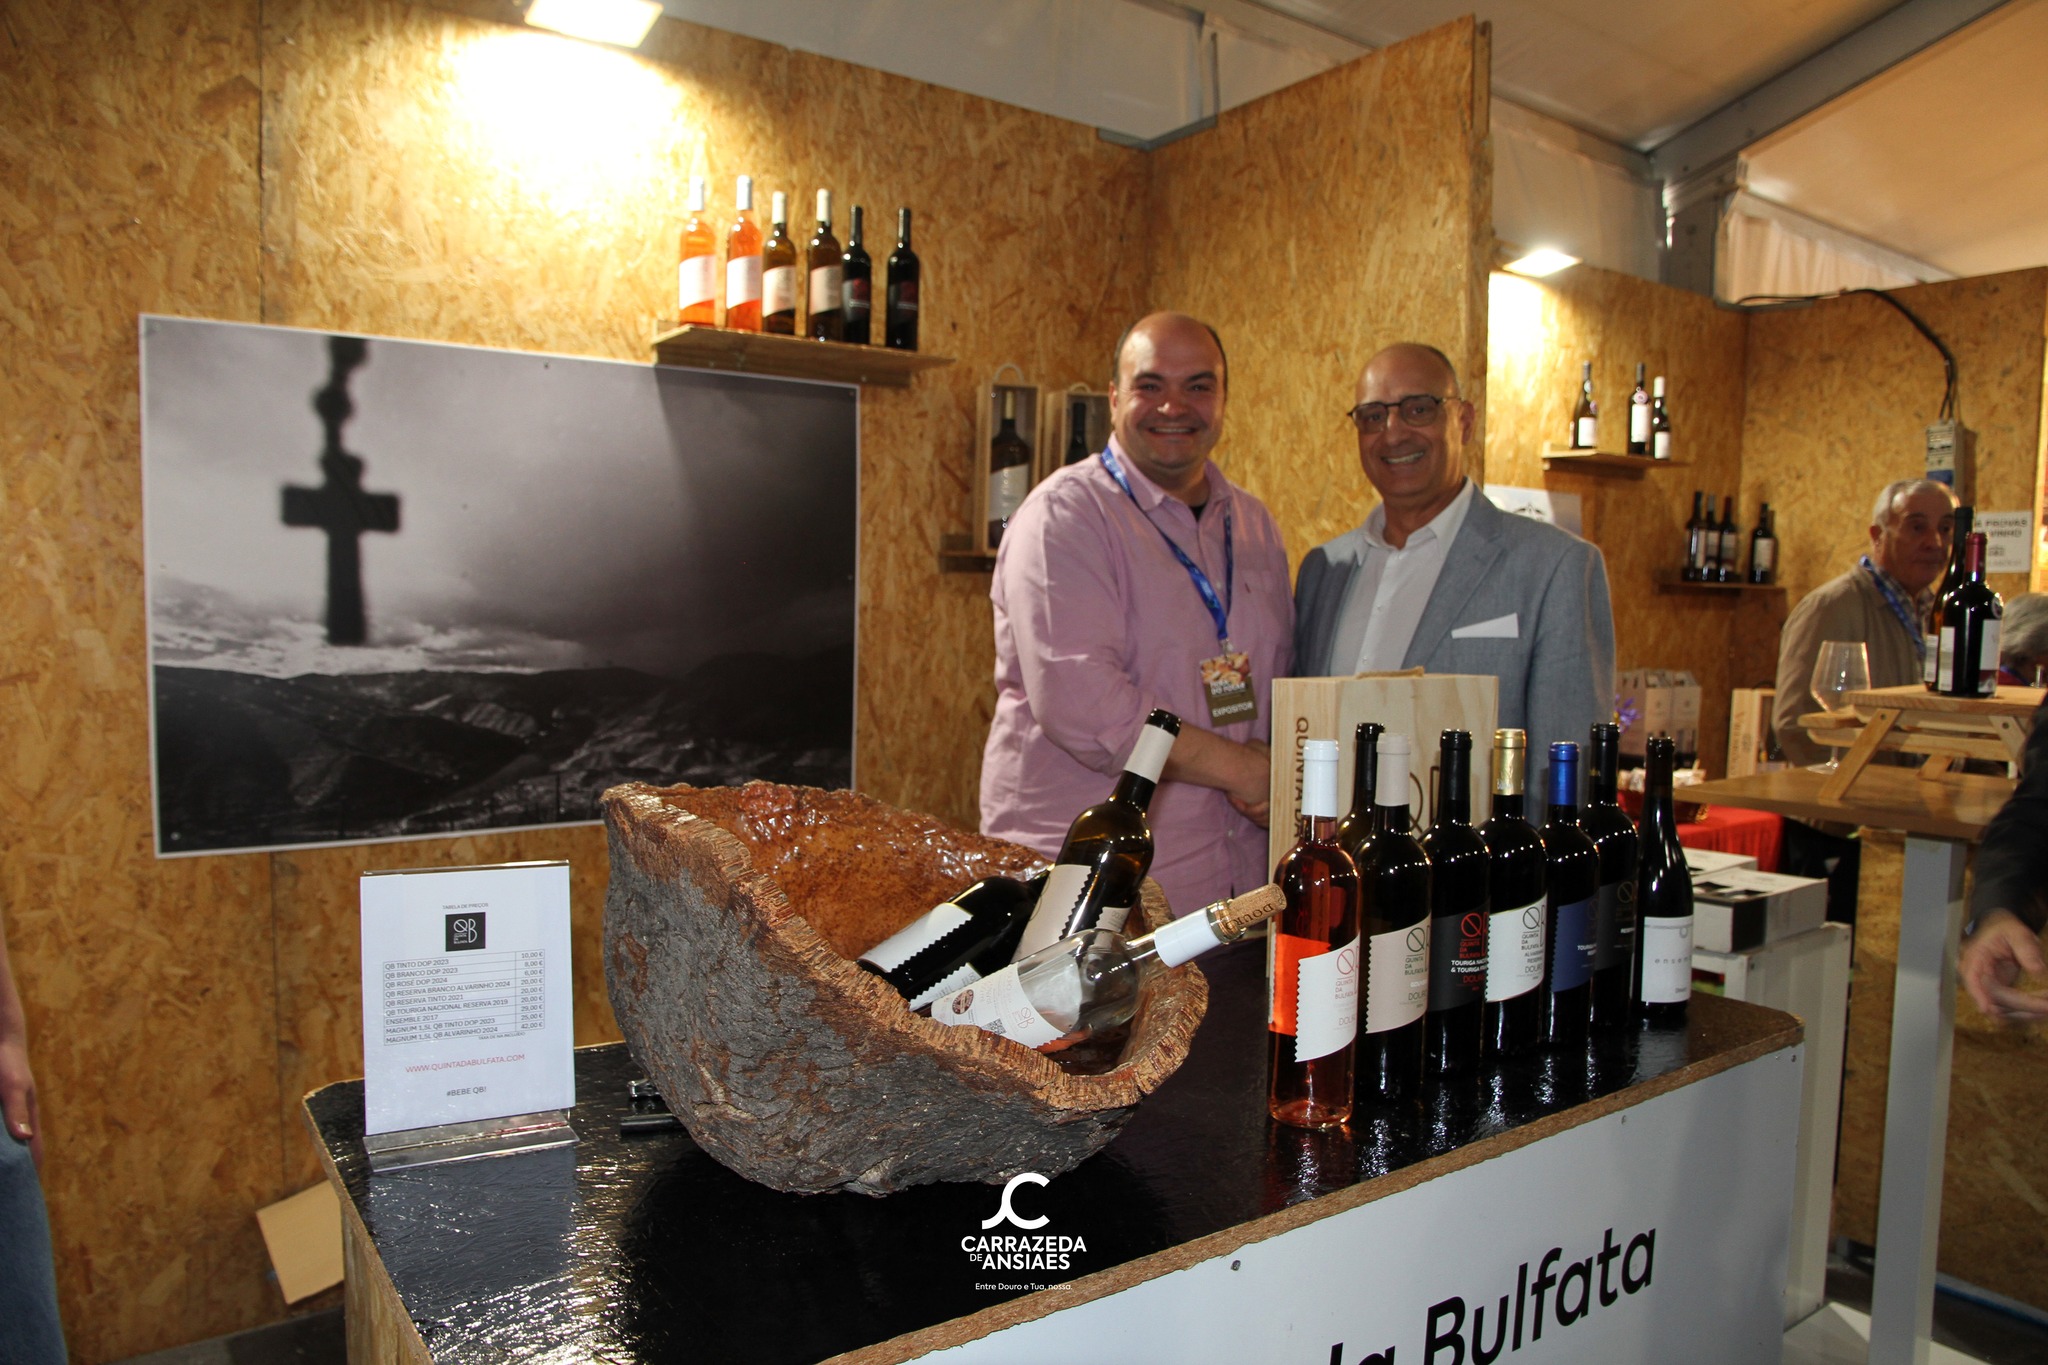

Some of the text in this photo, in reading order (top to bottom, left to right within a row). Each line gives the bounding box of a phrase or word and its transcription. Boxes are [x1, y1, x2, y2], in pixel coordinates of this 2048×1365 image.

[1212, 701, 1254, 717] EXPOSITOR
[384, 962, 396, 970] QB
[396, 961, 416, 969] TINTO
[433, 958, 449, 966] 2023
[521, 951, 538, 960] 10,00
[385, 971, 396, 979] QB
[396, 969, 426, 979] BRANCO
[426, 968, 442, 976] DOP
[442, 967, 458, 975] 2023
[1457, 965, 1480, 973] TOURIGA
[385, 980, 396, 988] QB
[396, 978, 415, 987] ROSÉ
[416, 978, 431, 986] DOP
[431, 977, 448, 985] 2024
[385, 990, 396, 998] QB
[396, 987, 427, 997] RESERVA
[427, 985, 456, 994] BRANCO
[456, 982, 495, 991] ALVARINHO
[494, 980, 511, 988] 2024
[520, 978, 538, 986] 20,00
[1335, 978, 1354, 987] QUINTA
[385, 999, 396, 1008] QB
[396, 997, 427, 1007] RESERVA
[427, 995, 447, 1003] TINTO
[447, 993, 464, 1001] 2021
[520, 987, 538, 995] 20,00
[1408, 989, 1428, 1000] DOUR
[385, 1009, 396, 1017] QB
[396, 1006, 427, 1016] TOURIGA
[427, 1003, 462, 1012] NACIONAL
[463, 1000, 492, 1009] RESERVA
[520, 995, 538, 1004] 20,00
[386, 1016, 421, 1026] ENSEMBLE
[422, 1014, 439, 1022] 2017
[386, 1025, 417, 1035] MAGNUM
[432, 1022, 443, 1030] QB
[444, 1020, 463, 1029] TINTO
[386, 1034, 417, 1044] MAGNUM
[432, 1031, 443, 1039] QB
[444, 1028, 482, 1038] ALVARINHO
[482, 1026, 498, 1034] 2024
[405, 1053, 526, 1073] WWW.QUINTADABULFATA.COM
[446, 1086, 487, 1097] #BEBE QB!
[1423, 1227, 1657, 1365] Bulfata
